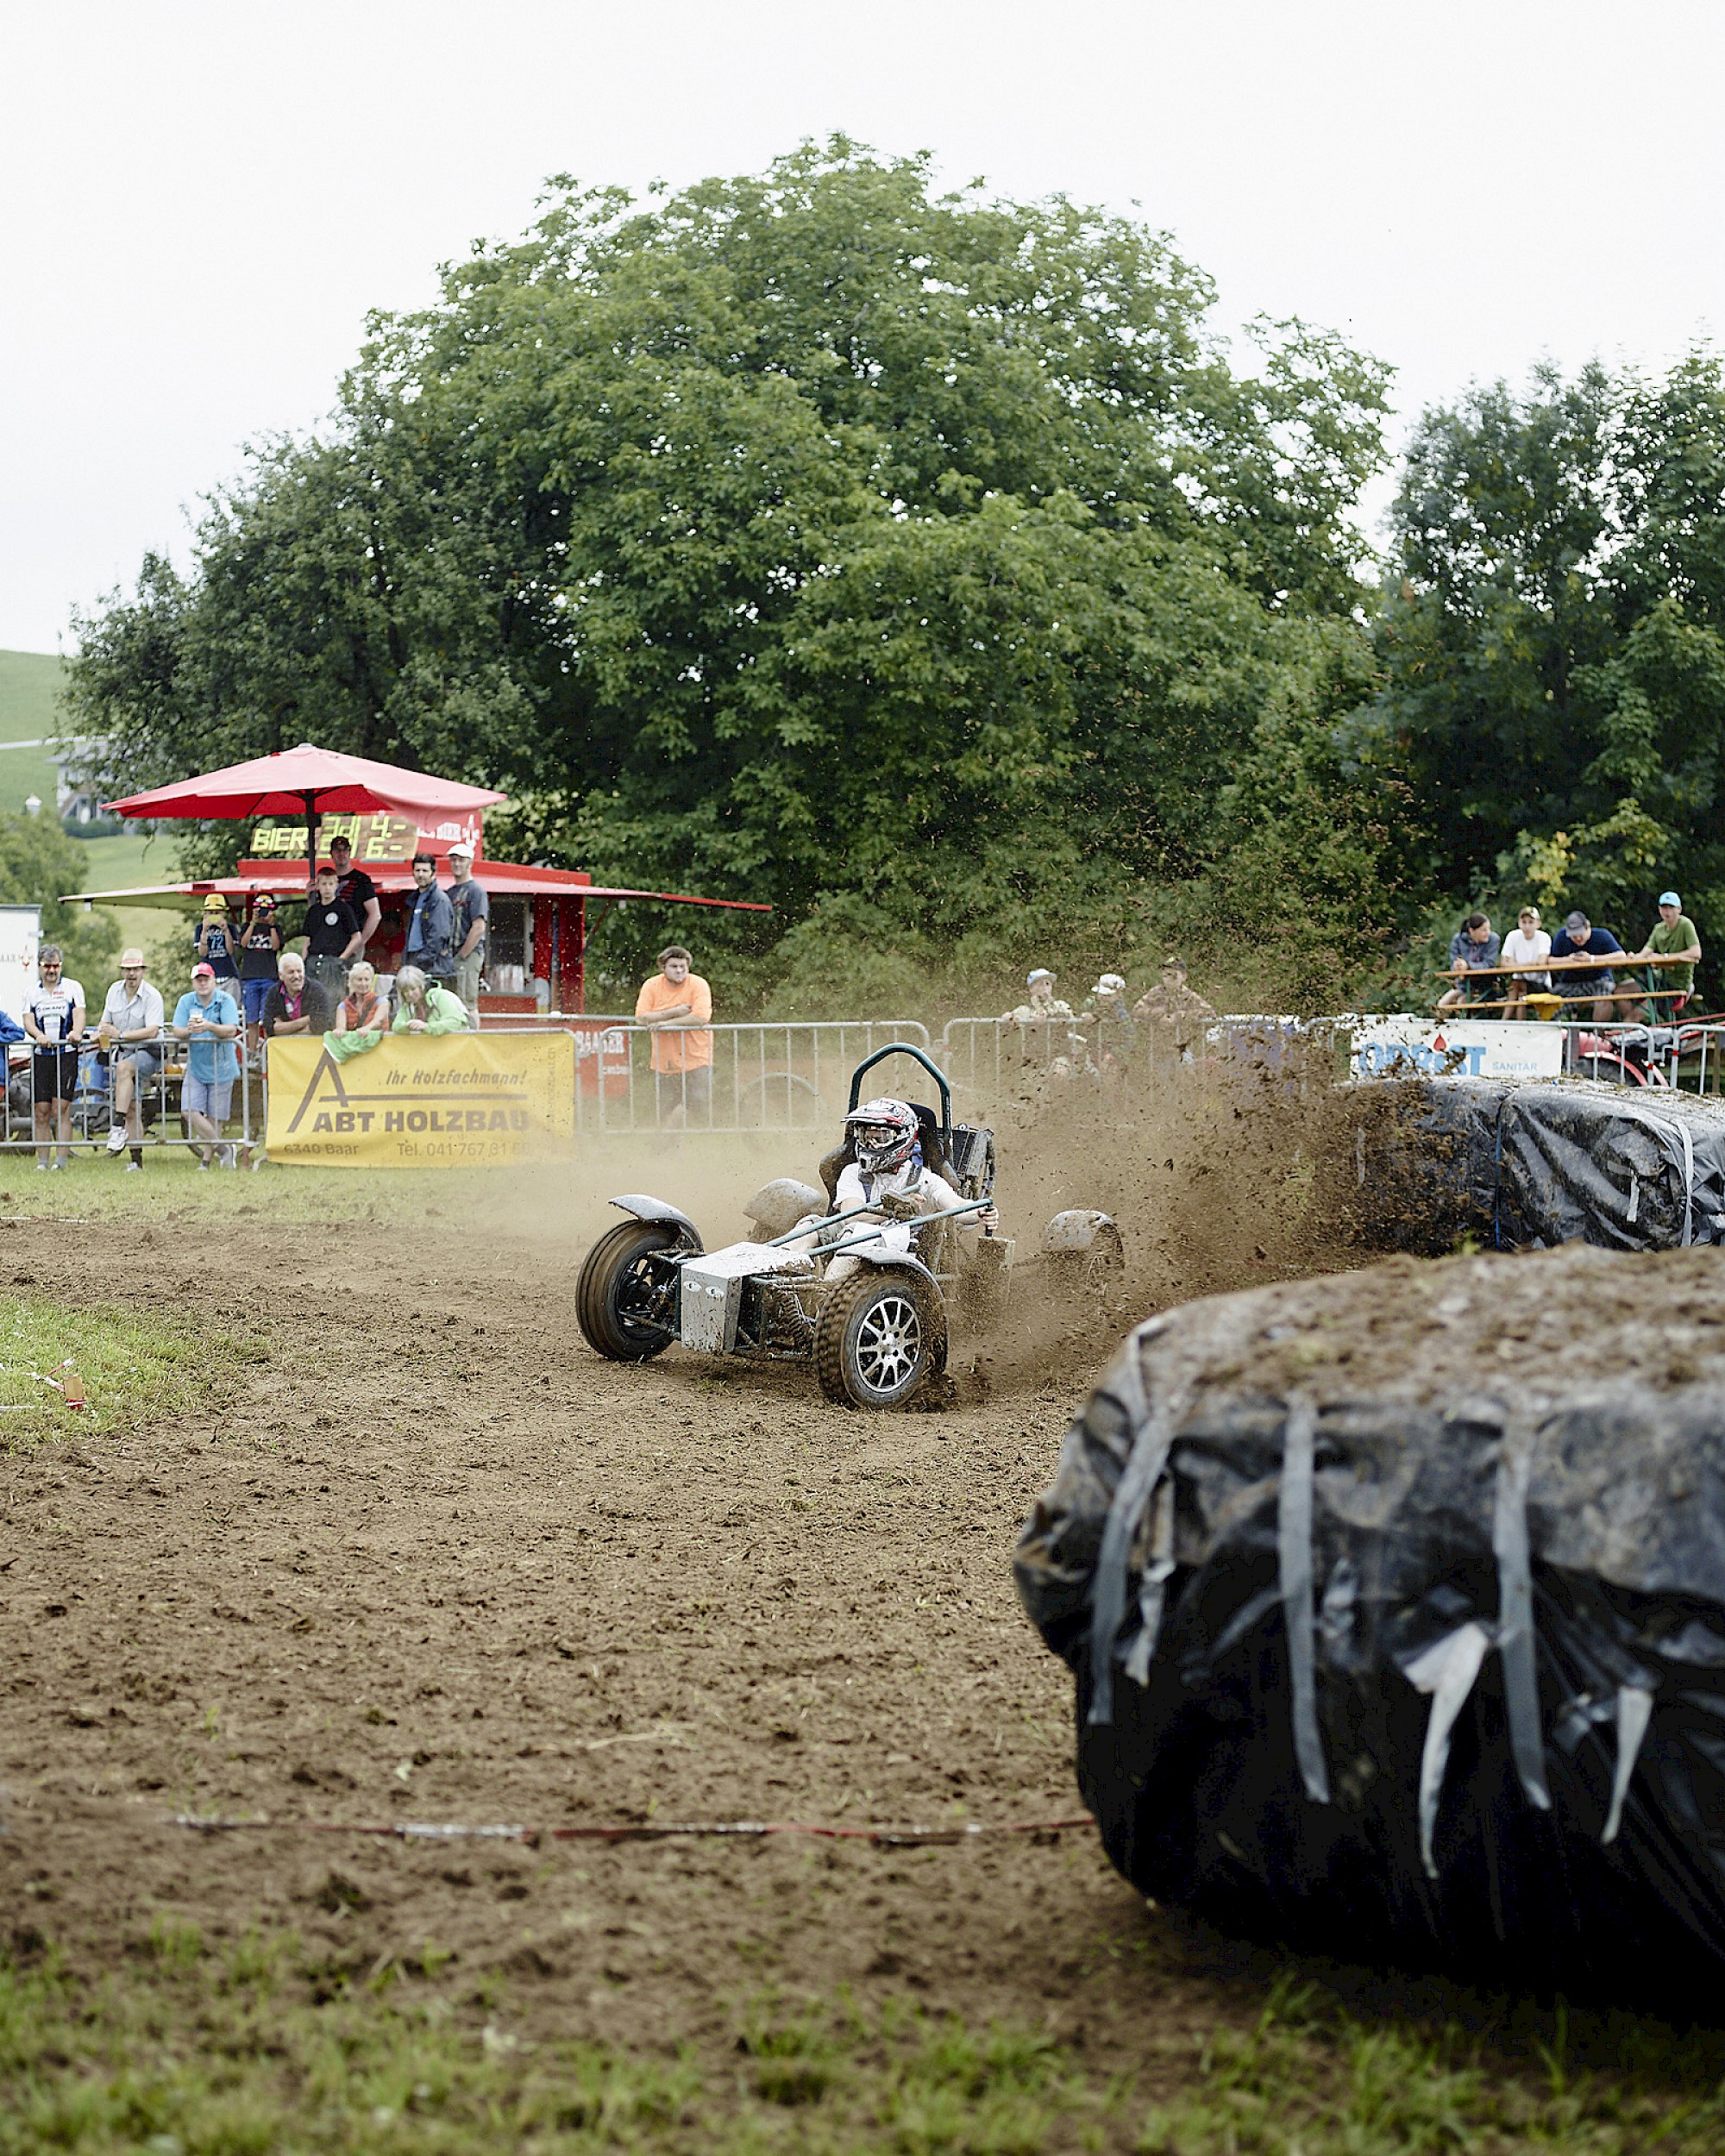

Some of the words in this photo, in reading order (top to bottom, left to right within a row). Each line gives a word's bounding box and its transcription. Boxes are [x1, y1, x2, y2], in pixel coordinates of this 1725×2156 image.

[254, 827, 309, 851] BIER
[210, 935, 224, 950] 72
[386, 1070, 407, 1086] Ihr
[413, 1068, 528, 1086] Holzfachmann!
[312, 1112, 375, 1133] ABT
[385, 1110, 530, 1132] HOLZBAU
[284, 1143, 321, 1155] 6340
[325, 1143, 360, 1156] Baar
[397, 1142, 422, 1156] Tel.
[426, 1142, 453, 1156] 041
[458, 1142, 486, 1156] 767
